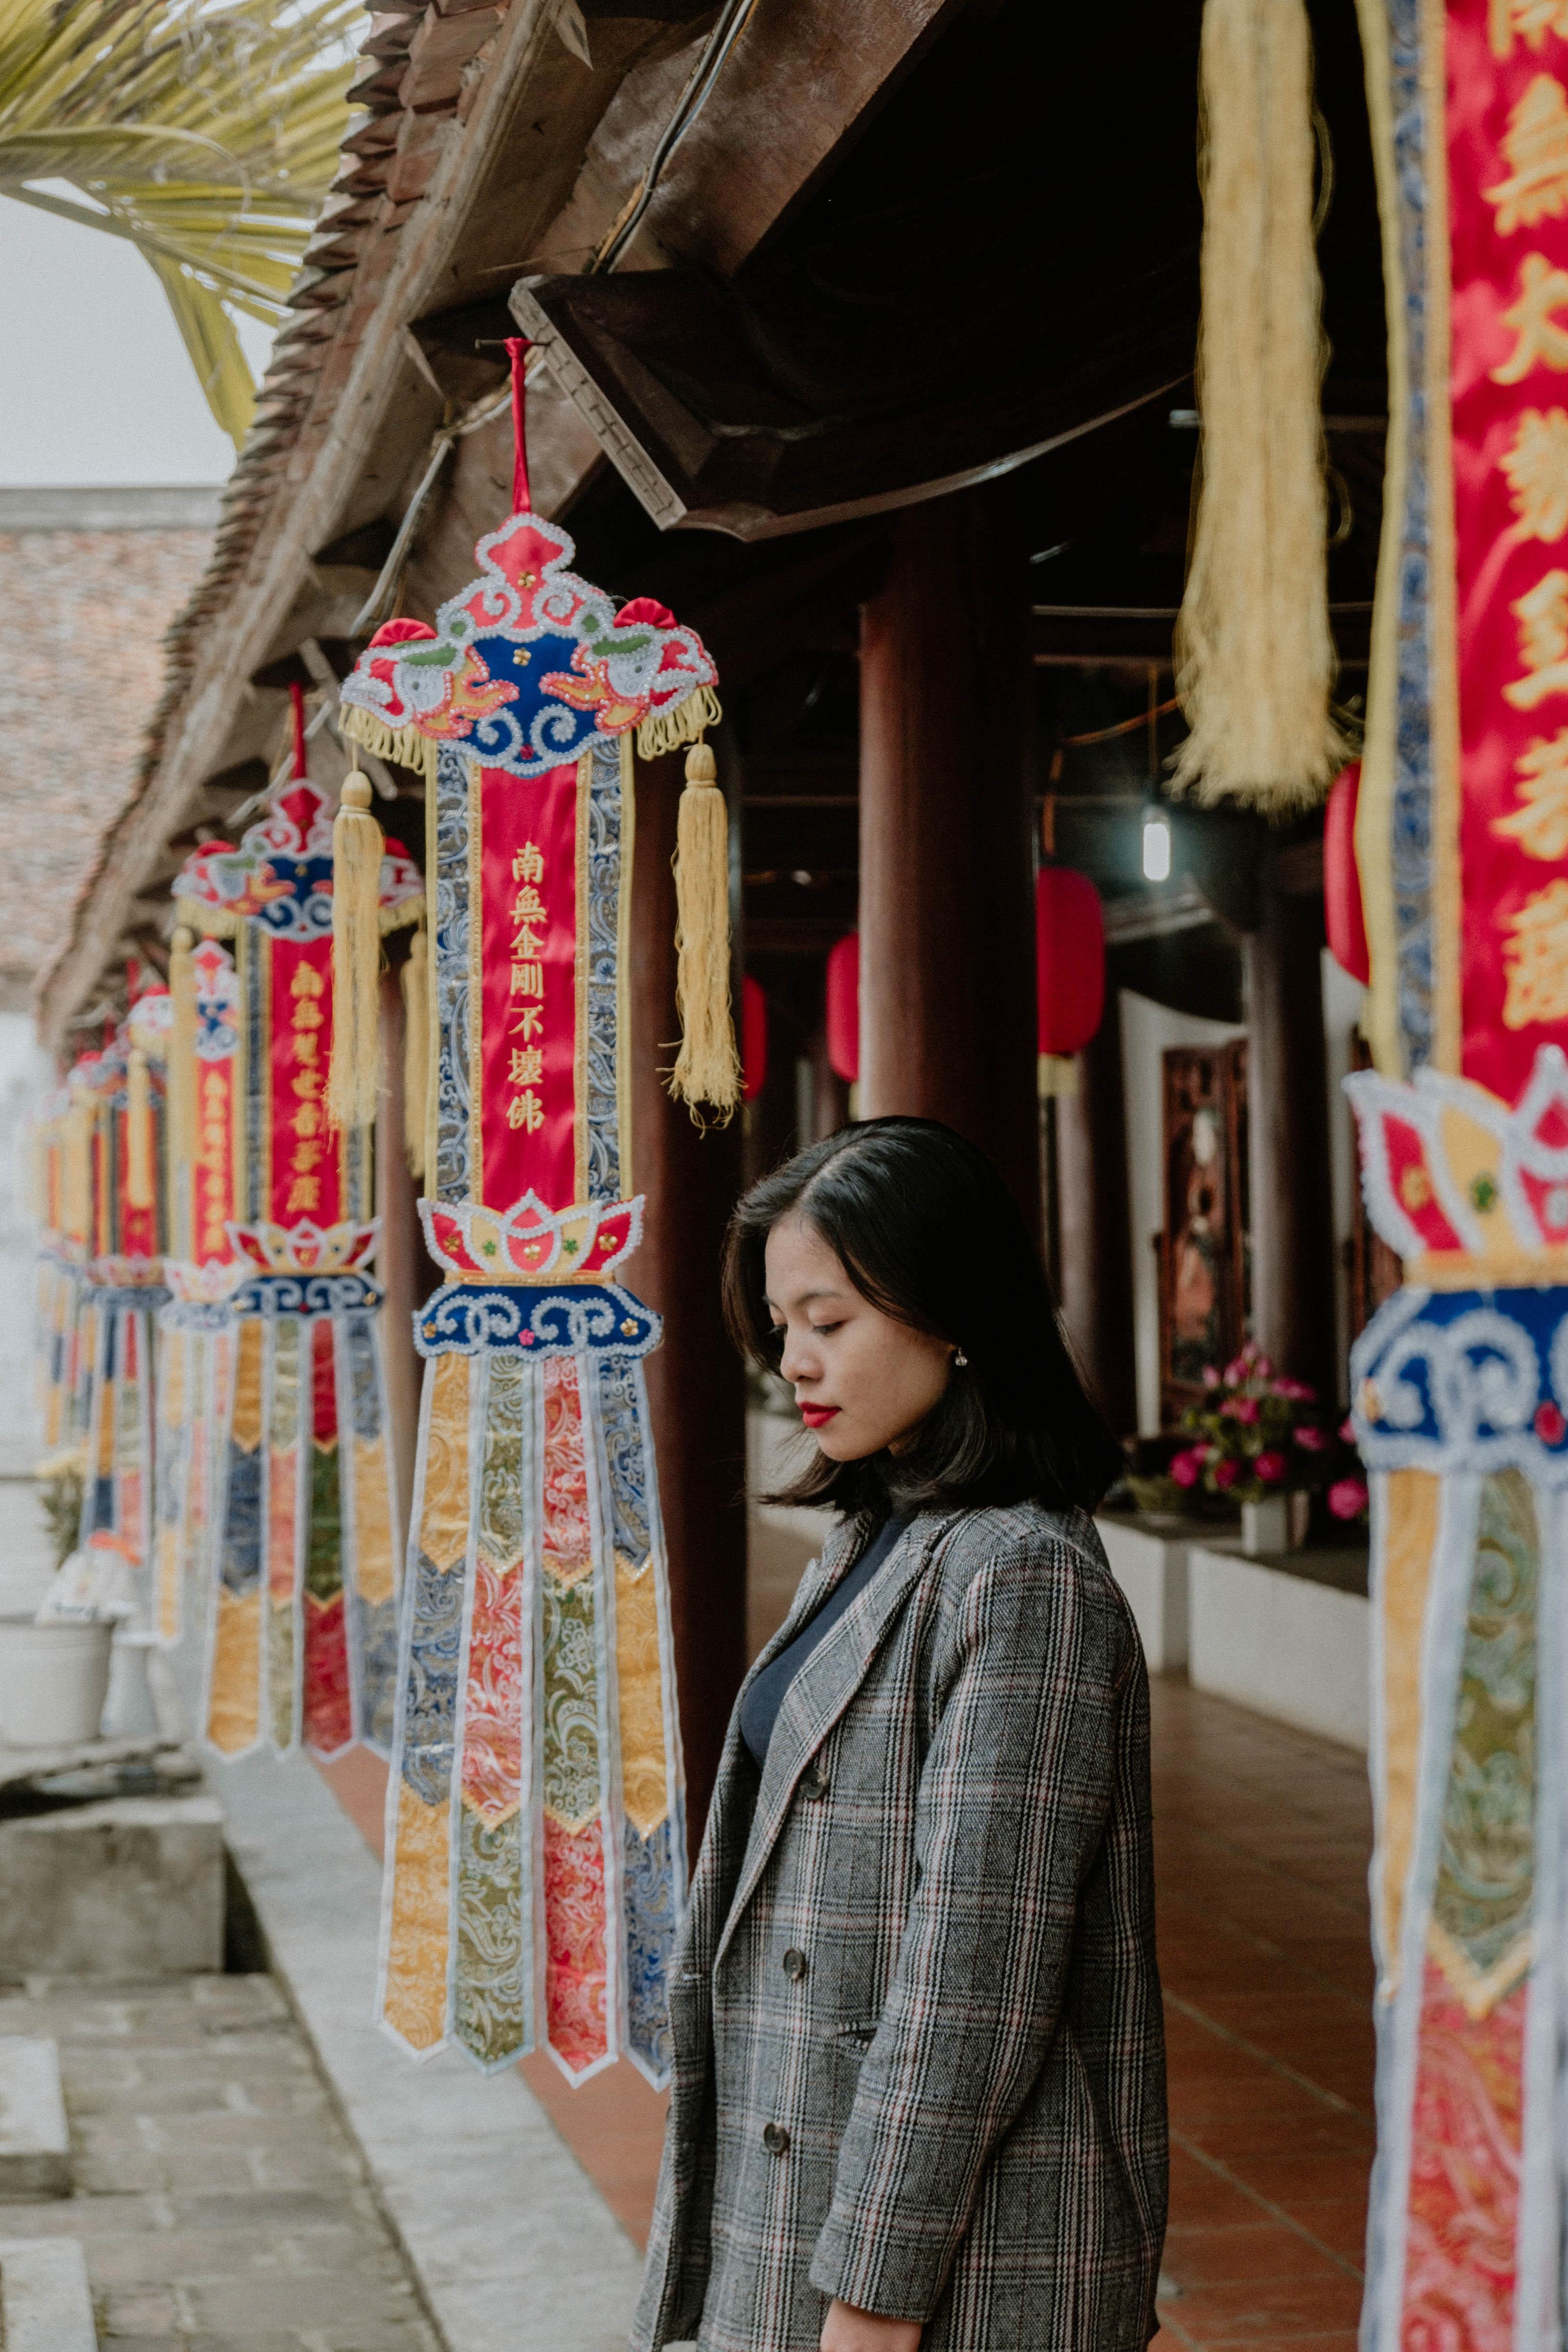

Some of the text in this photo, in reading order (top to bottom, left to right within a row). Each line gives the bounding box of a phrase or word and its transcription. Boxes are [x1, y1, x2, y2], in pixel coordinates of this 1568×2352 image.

[506, 841, 547, 1134] 南無金剛不壞佛
